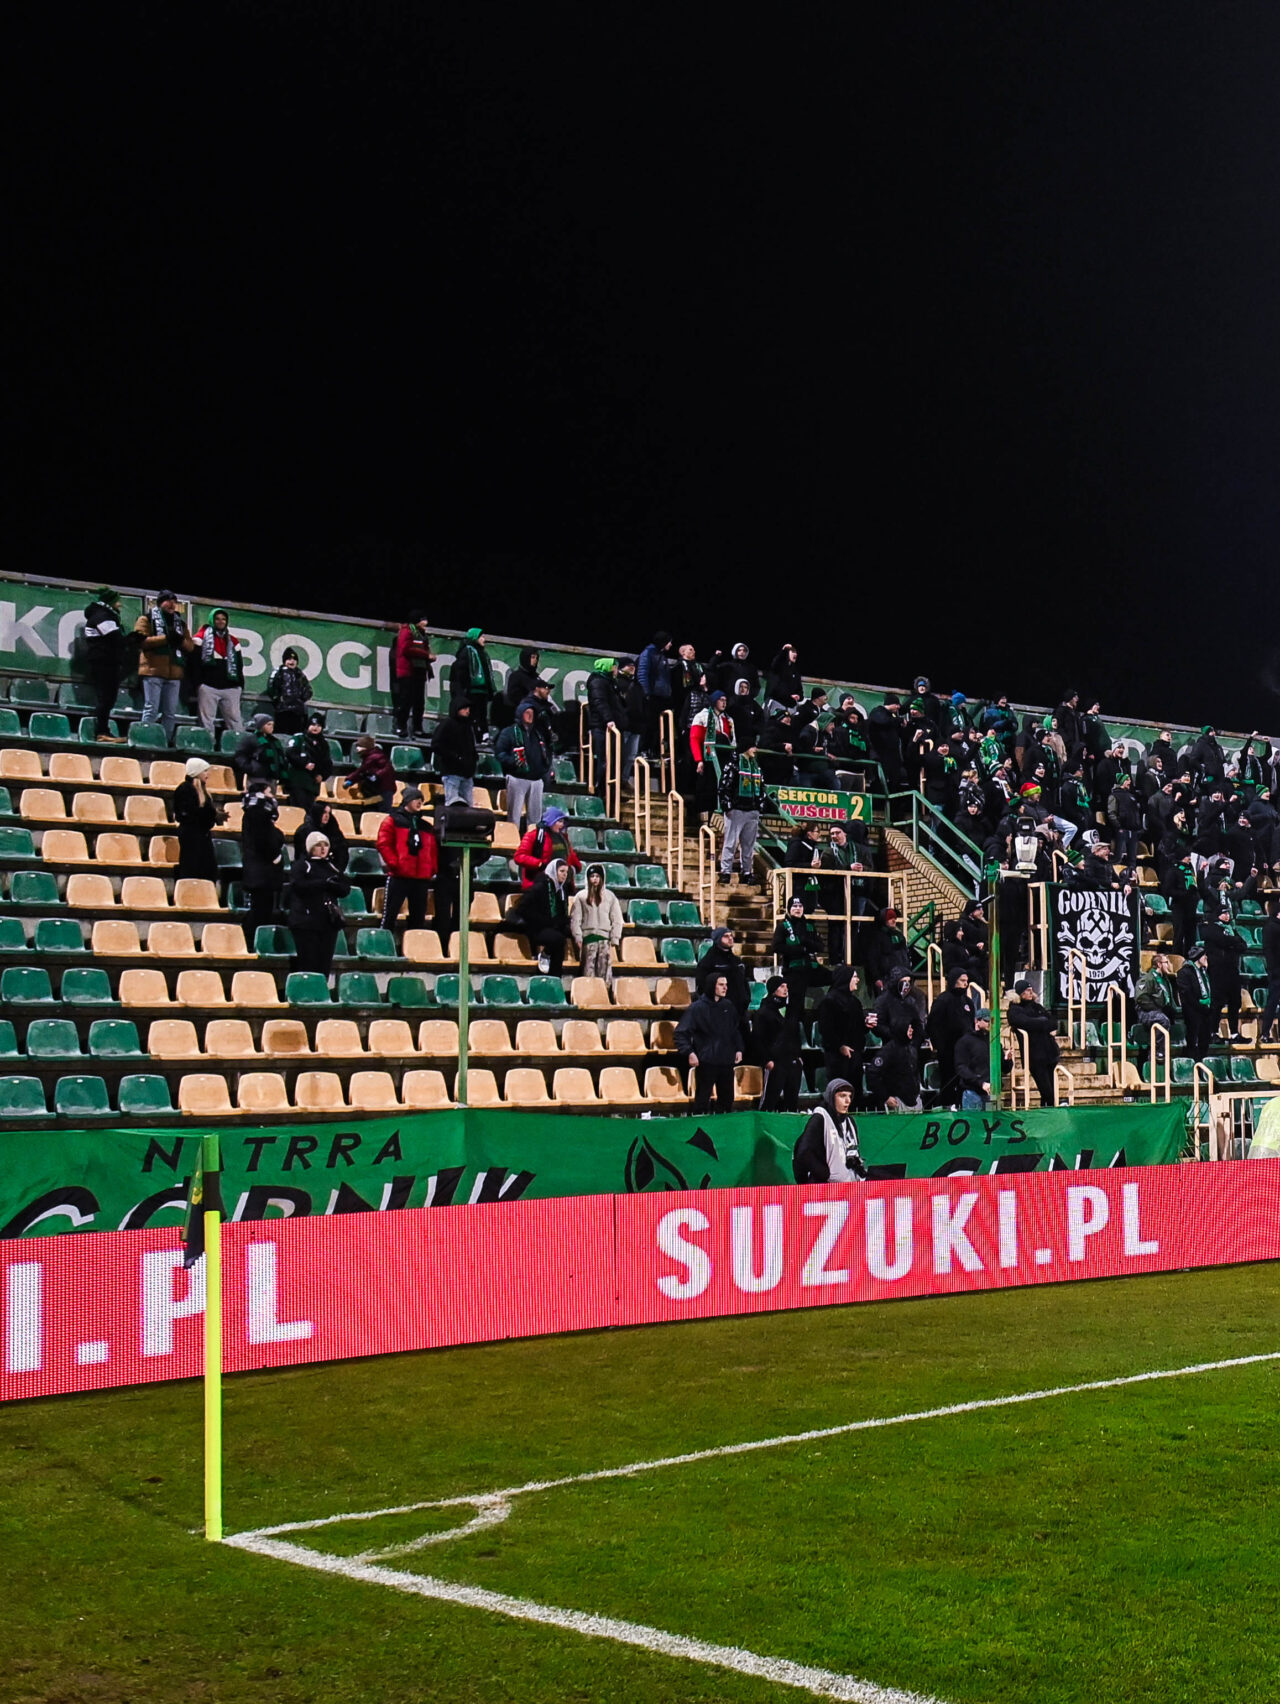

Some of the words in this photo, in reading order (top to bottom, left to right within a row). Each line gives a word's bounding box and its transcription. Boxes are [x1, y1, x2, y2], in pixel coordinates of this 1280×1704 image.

[777, 789, 838, 805] SEKTOR
[850, 795, 864, 820] 2
[1088, 970, 1105, 978] 1979
[919, 1118, 1029, 1150] BOYS
[141, 1129, 403, 1174] NTRRA
[656, 1182, 1160, 1300] SUZUKI.PL
